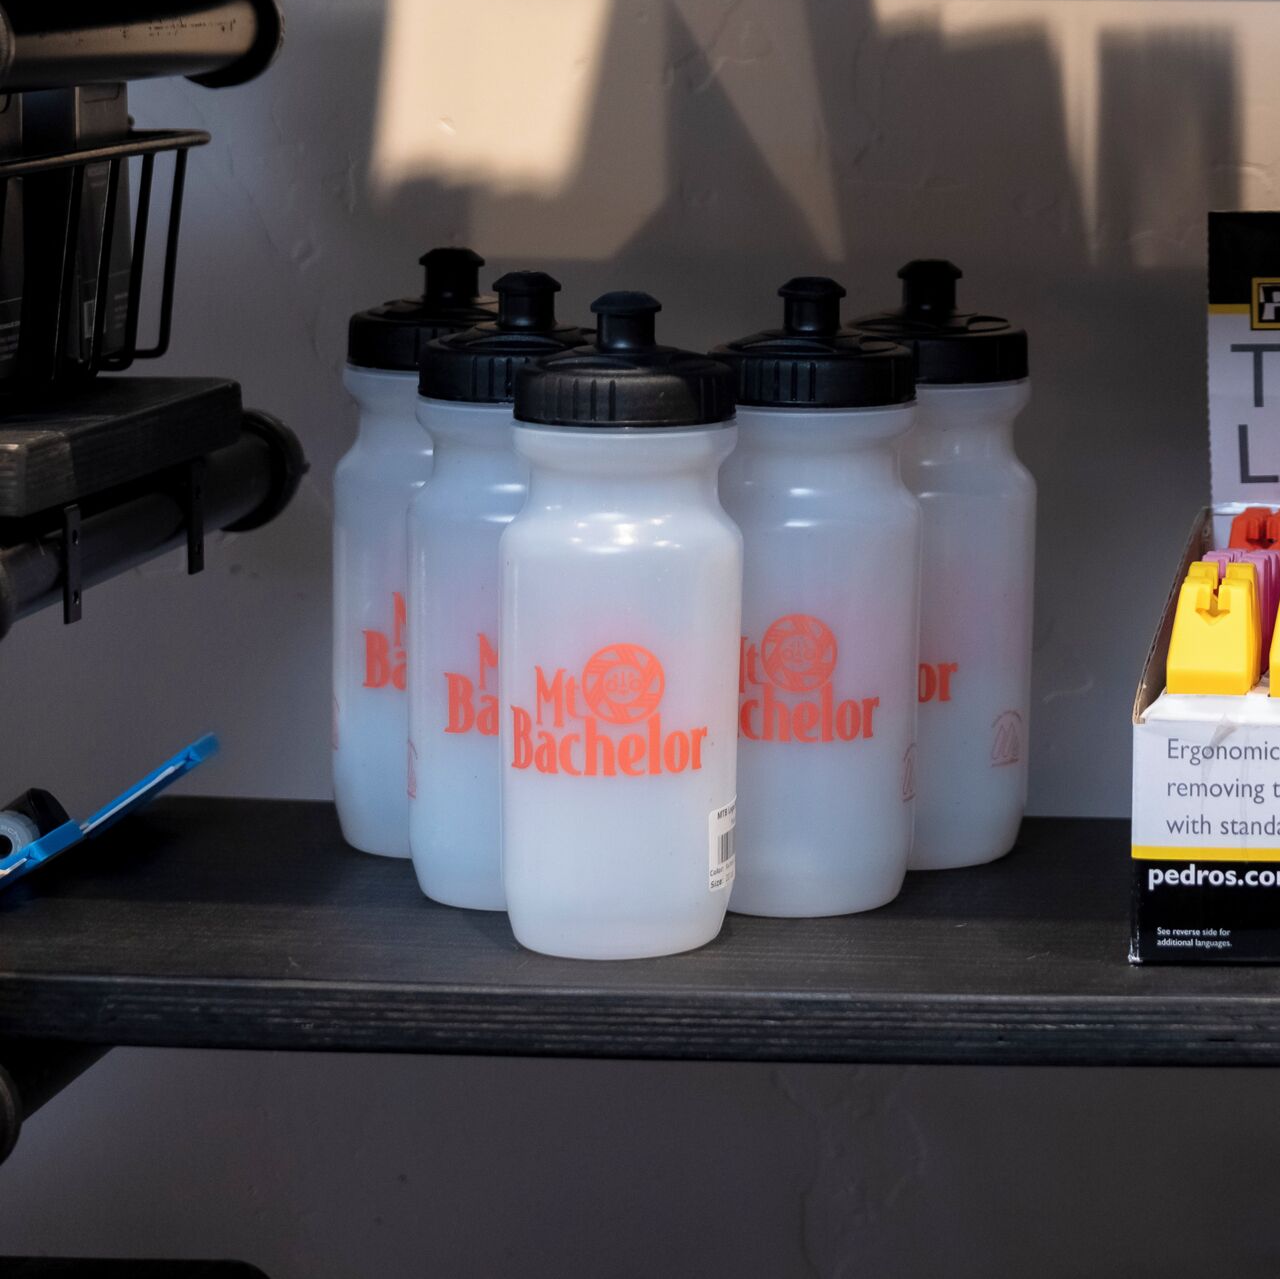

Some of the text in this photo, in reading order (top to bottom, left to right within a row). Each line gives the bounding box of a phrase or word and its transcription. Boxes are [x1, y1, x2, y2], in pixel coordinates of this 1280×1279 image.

[535, 666, 580, 728] Mt
[511, 704, 709, 777] Bachelor
[1167, 738, 1280, 766] Ergonomic
[1167, 779, 1265, 804] removing
[1166, 816, 1211, 835] with
